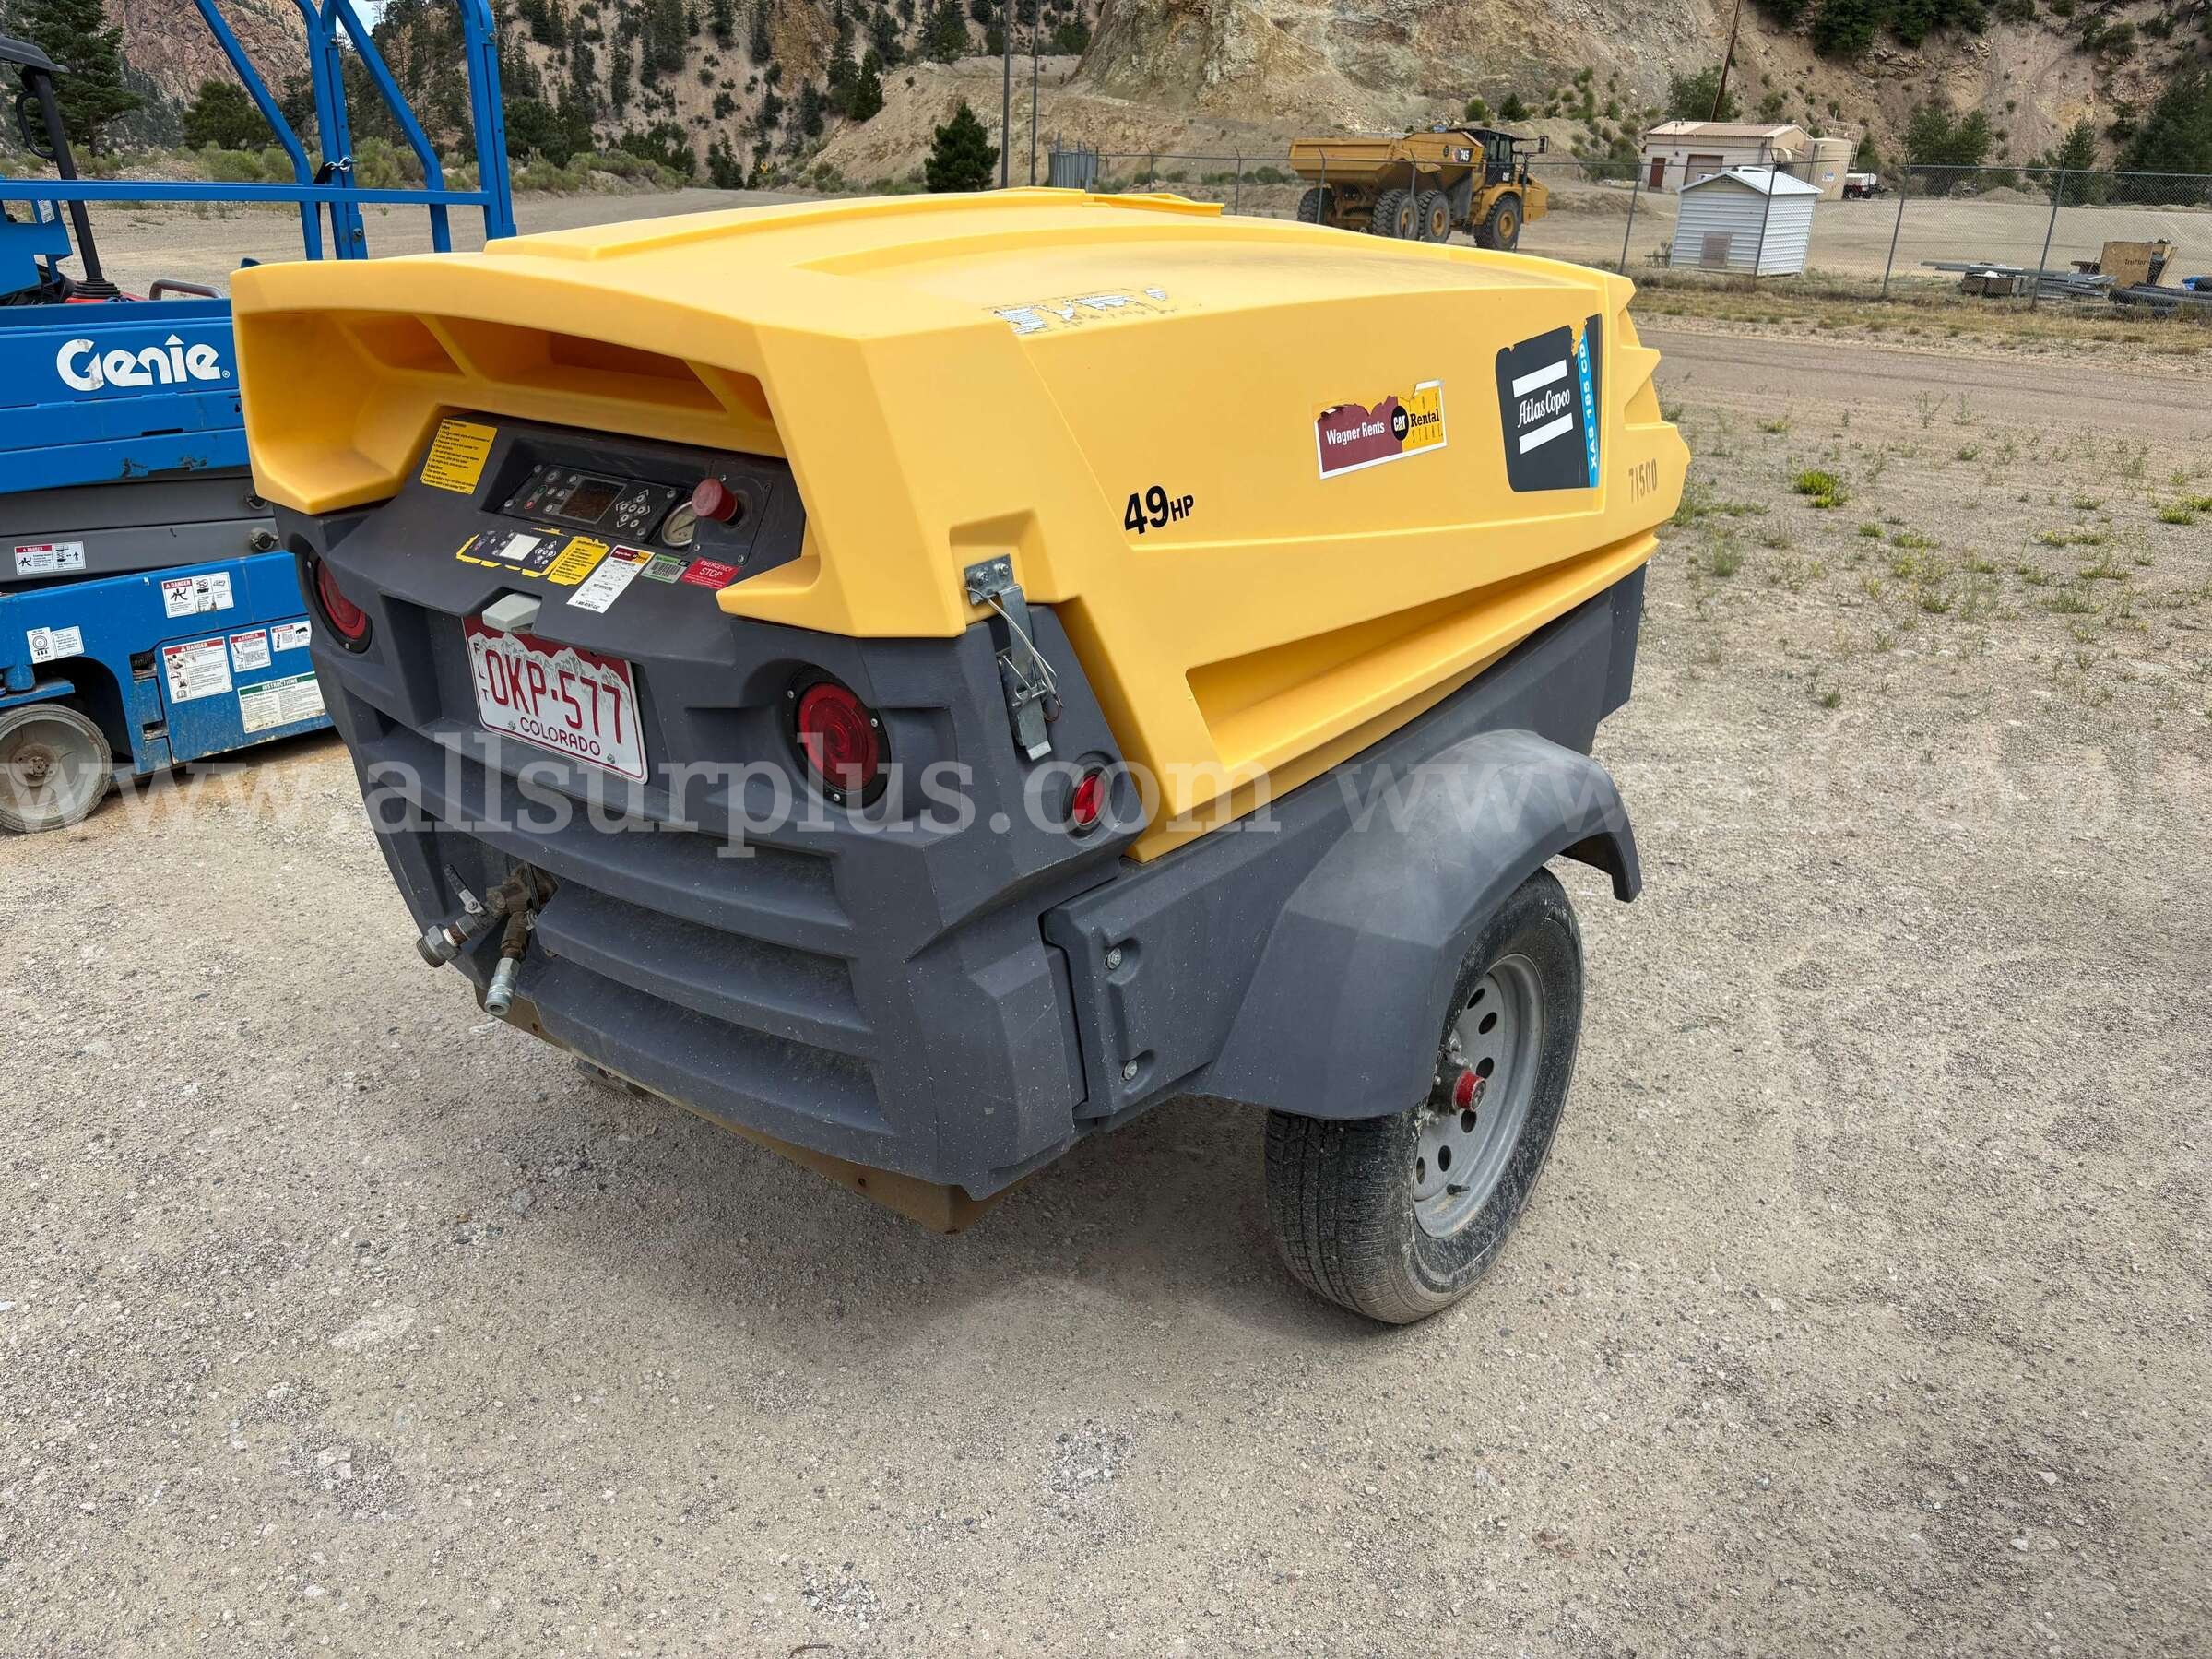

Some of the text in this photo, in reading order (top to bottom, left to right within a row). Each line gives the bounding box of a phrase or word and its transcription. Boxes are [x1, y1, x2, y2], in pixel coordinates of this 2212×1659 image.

[1518, 389, 1570, 428] Atlas Copco
[1583, 383, 1593, 419] 185
[1326, 409, 1440, 445] Wagner Rents CAT Rental
[1587, 428, 1598, 468] XAS
[172, 580, 191, 588] DANGER
[699, 566, 723, 578] STOP
[520, 717, 602, 757] COLORADO
